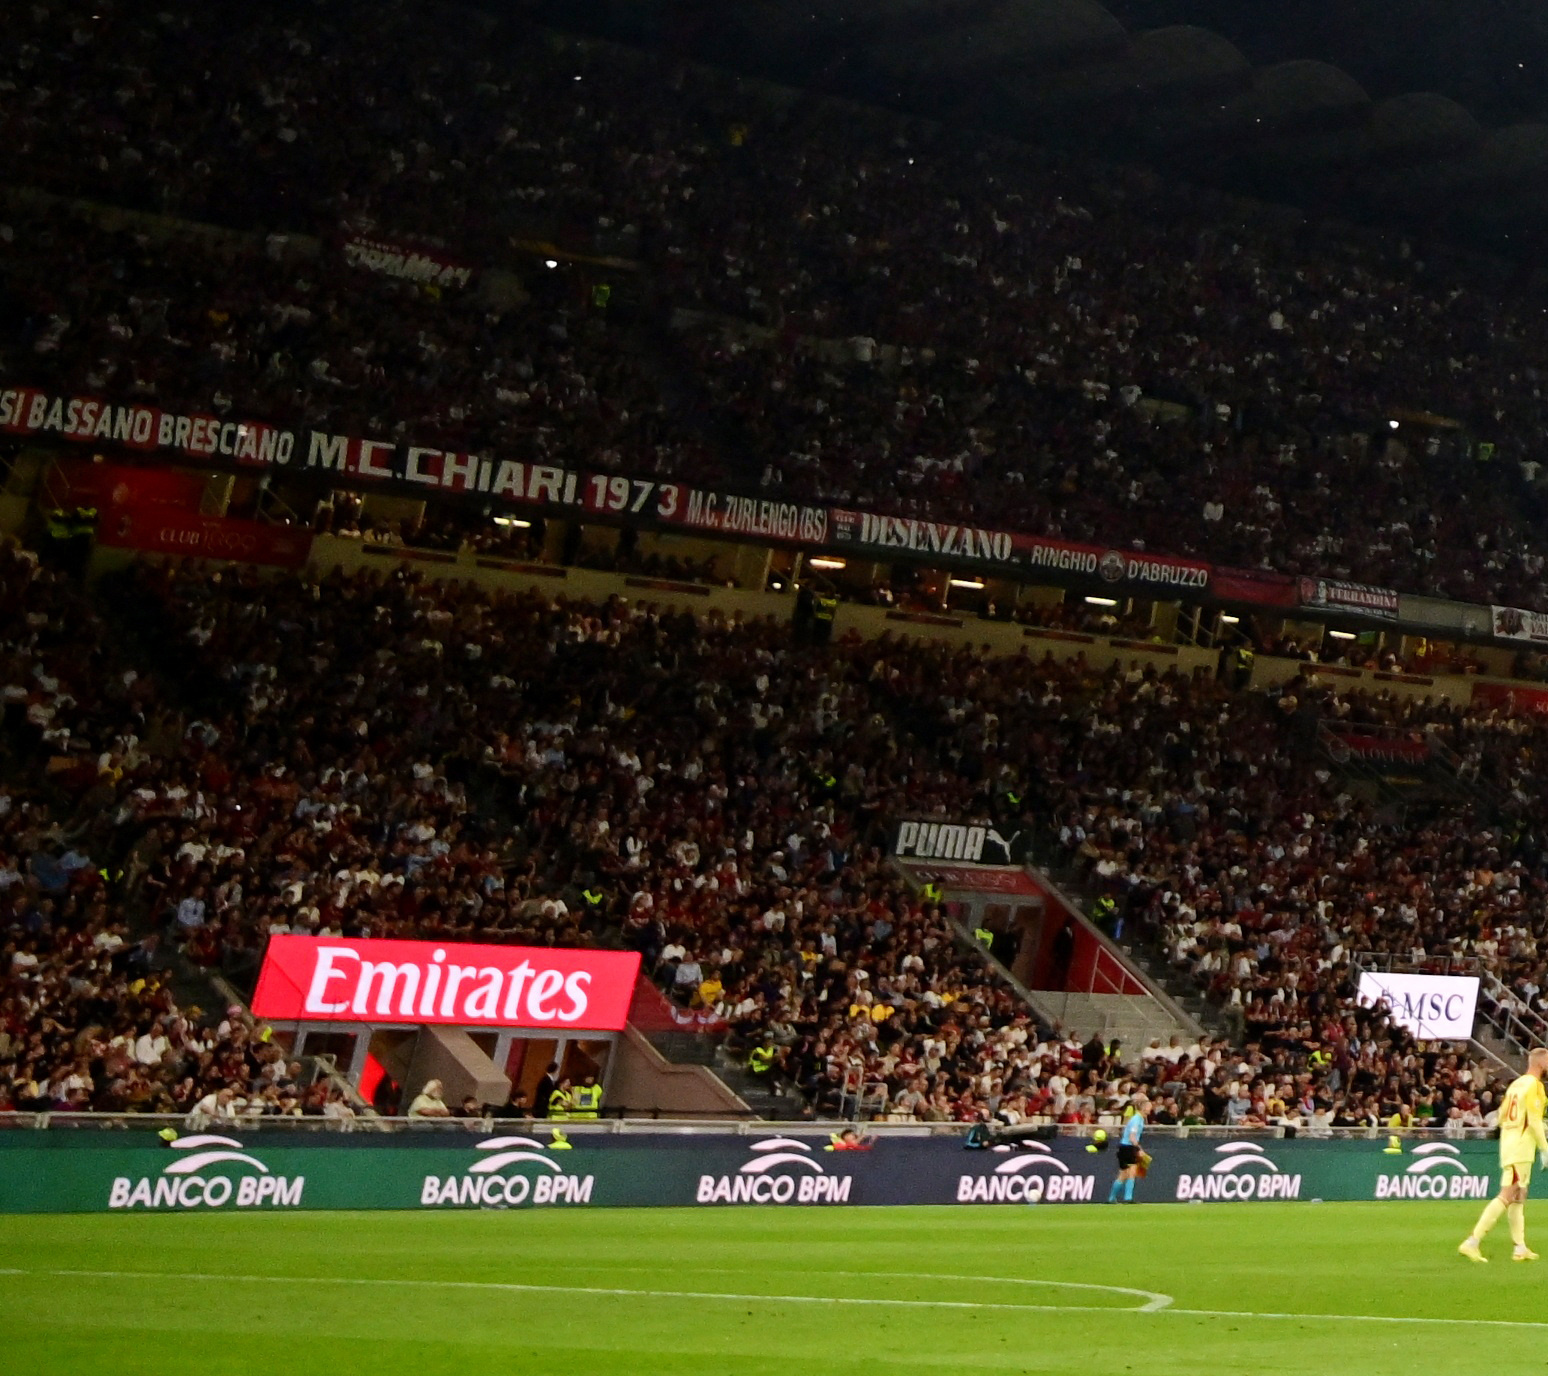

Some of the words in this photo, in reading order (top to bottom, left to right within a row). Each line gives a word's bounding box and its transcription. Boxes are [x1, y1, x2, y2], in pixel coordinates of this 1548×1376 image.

[26, 392, 153, 445] BASSANO
[157, 411, 296, 466] BRESCIANO
[590, 473, 680, 517] 1973
[724, 494, 799, 539] ZURLENGO
[799, 505, 829, 541] (BS)
[160, 527, 200, 545] CLUB
[860, 511, 1013, 562] DESENZANO
[1031, 544, 1097, 573] RINGHIO
[1127, 559, 1209, 589] D'ABRUZZO
[895, 821, 986, 860] PUMA
[304, 945, 592, 1022] Emirates
[1399, 990, 1465, 1023] MSC
[109, 1176, 232, 1208] BANCO
[237, 1176, 305, 1206] BPM
[421, 1175, 530, 1205] BANCO
[533, 1175, 594, 1204] BPM
[697, 1175, 795, 1203] BANCO
[798, 1175, 852, 1203] BPM
[958, 1175, 1044, 1201] BANCO
[1046, 1176, 1095, 1201] BPM
[1176, 1174, 1255, 1199] BANCO
[1258, 1174, 1301, 1199] BPM
[1375, 1174, 1447, 1198] BANCO
[1449, 1175, 1489, 1198] BPM
